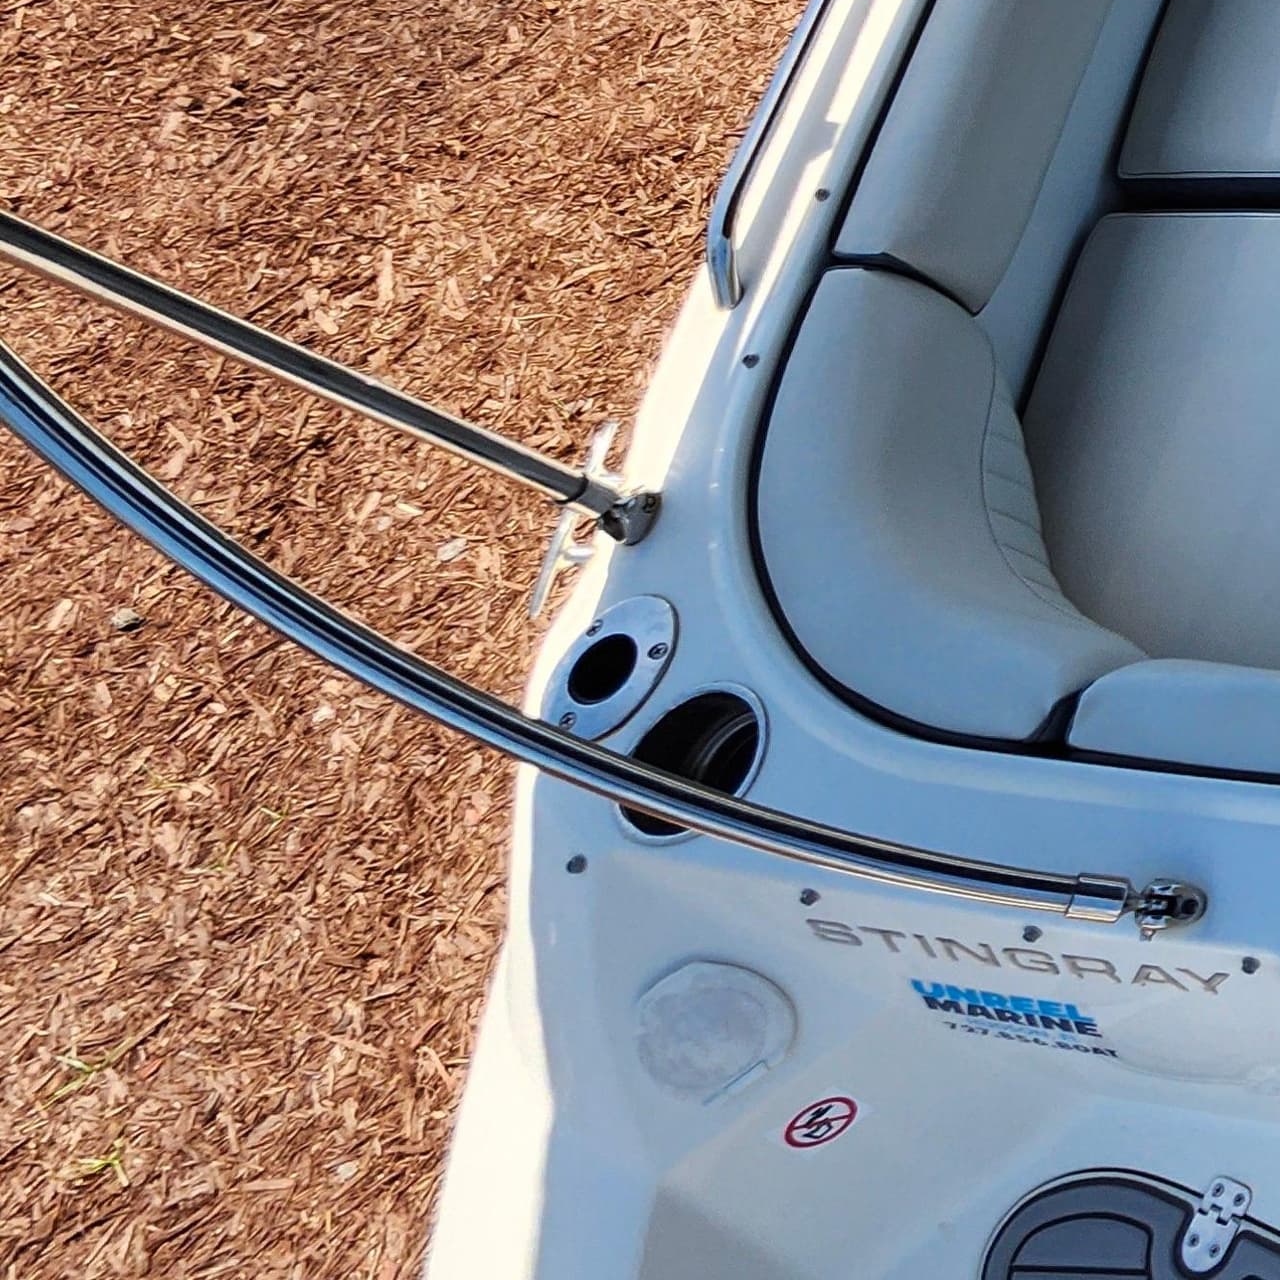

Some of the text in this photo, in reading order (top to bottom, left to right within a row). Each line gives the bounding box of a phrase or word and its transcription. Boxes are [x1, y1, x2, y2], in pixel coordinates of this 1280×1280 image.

[808, 919, 1231, 995] STINGRAY
[911, 978, 1095, 1023] UNREEL
[922, 996, 1102, 1038] MARINE
